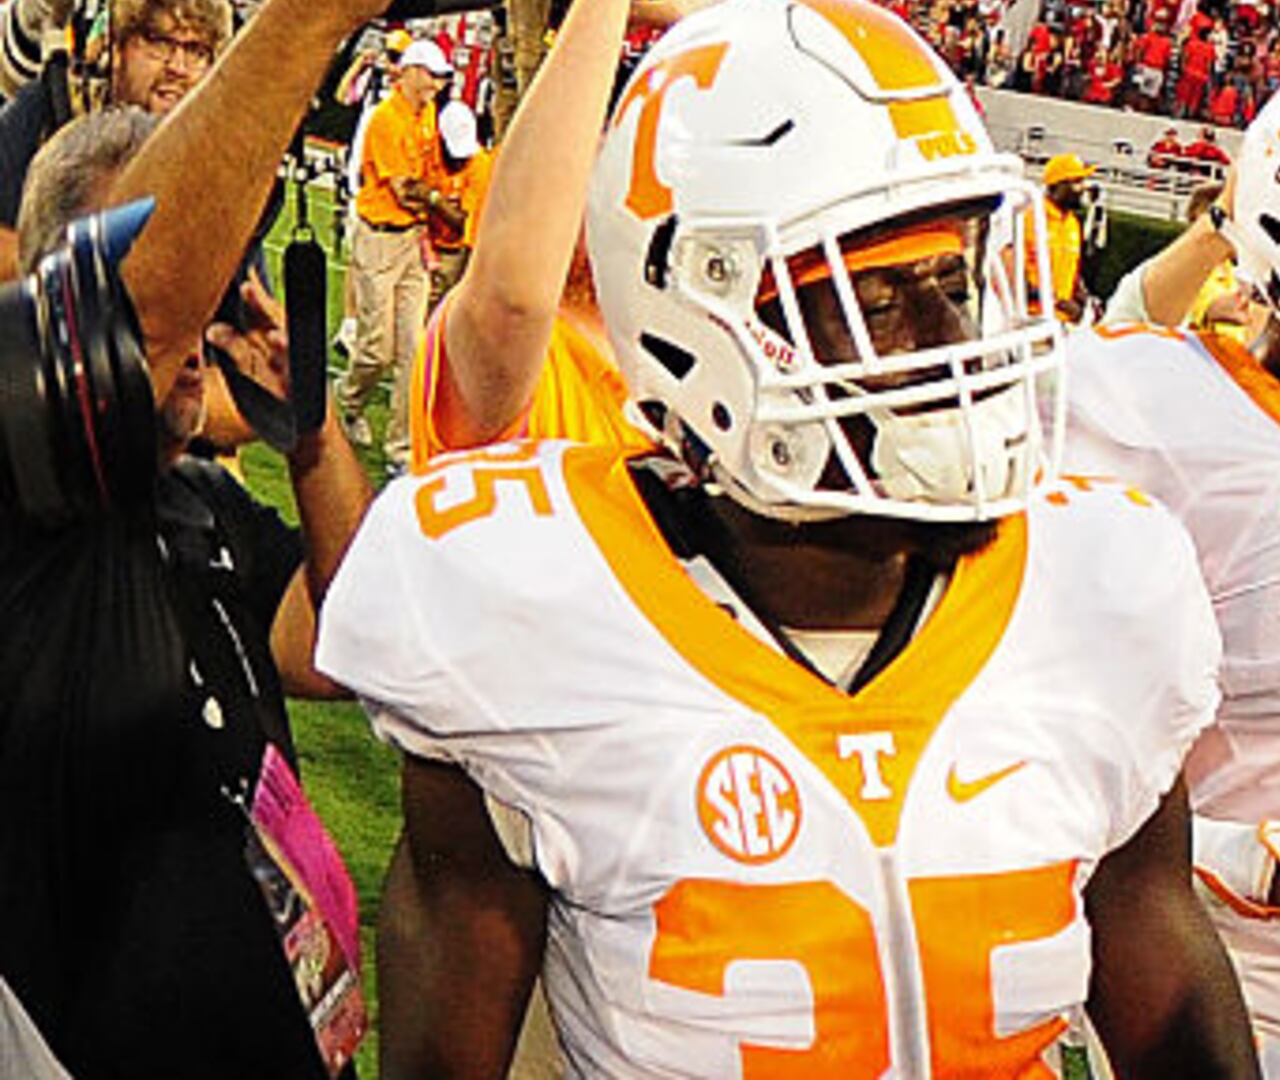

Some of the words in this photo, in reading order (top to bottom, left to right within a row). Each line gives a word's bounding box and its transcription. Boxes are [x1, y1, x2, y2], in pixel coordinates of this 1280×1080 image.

[614, 41, 731, 220] T
[703, 752, 796, 856] SEC
[837, 730, 896, 800] T
